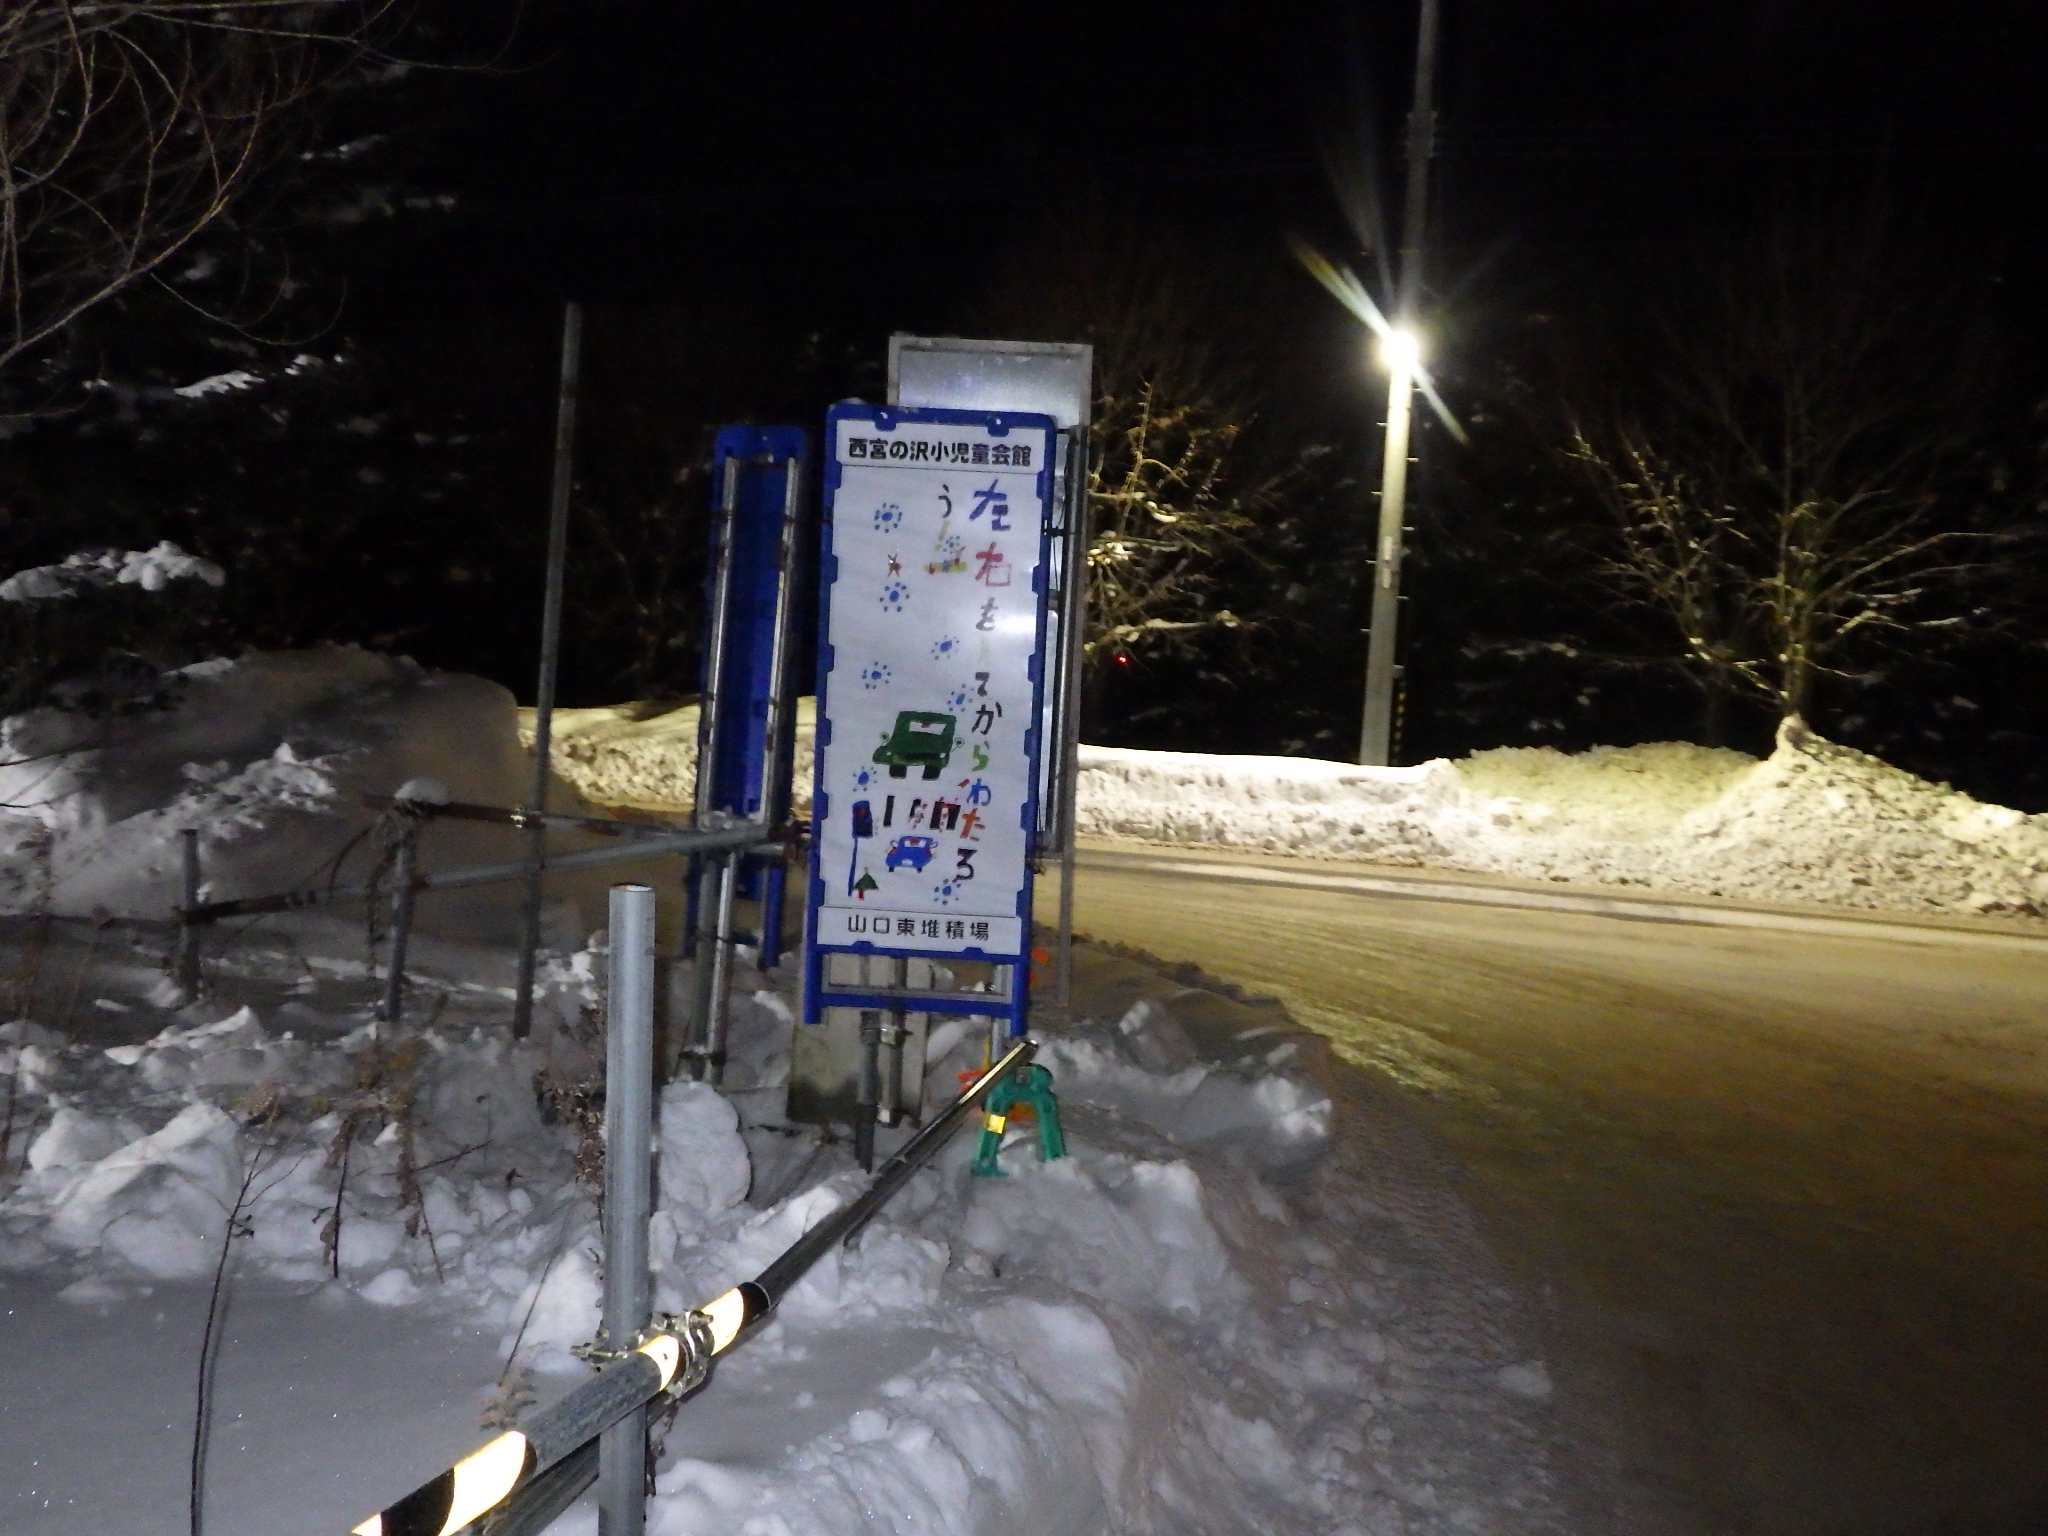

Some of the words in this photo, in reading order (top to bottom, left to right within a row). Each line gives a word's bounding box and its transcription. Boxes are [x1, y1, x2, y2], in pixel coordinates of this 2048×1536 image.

[848, 436, 1033, 467] 西宮の沢小児童会館
[847, 914, 990, 942] 山口東堆積場
